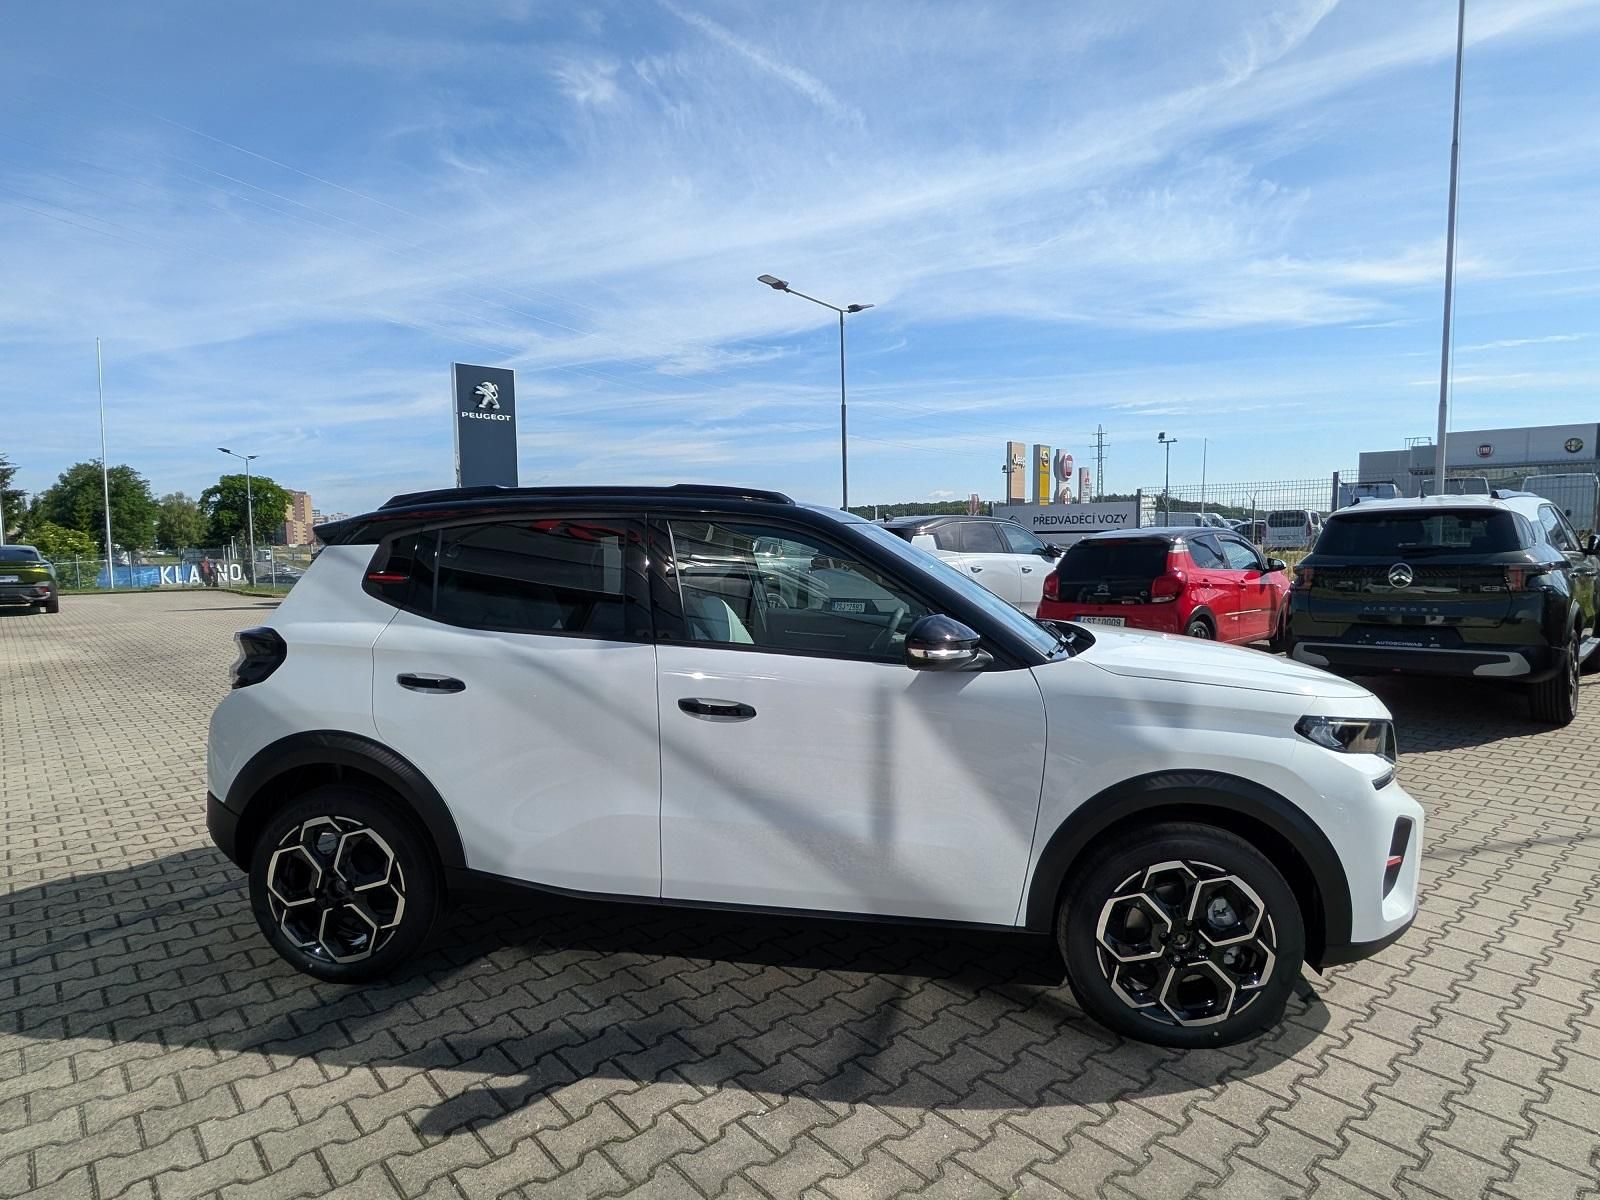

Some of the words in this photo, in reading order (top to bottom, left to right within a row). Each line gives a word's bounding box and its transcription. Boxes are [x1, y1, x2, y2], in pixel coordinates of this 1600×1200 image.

[461, 411, 512, 422] PEUGEOT
[1032, 513, 1095, 525] PŘEDVÁDĚCÍ
[1097, 513, 1128, 524] VOZY
[160, 563, 242, 585] KLANO
